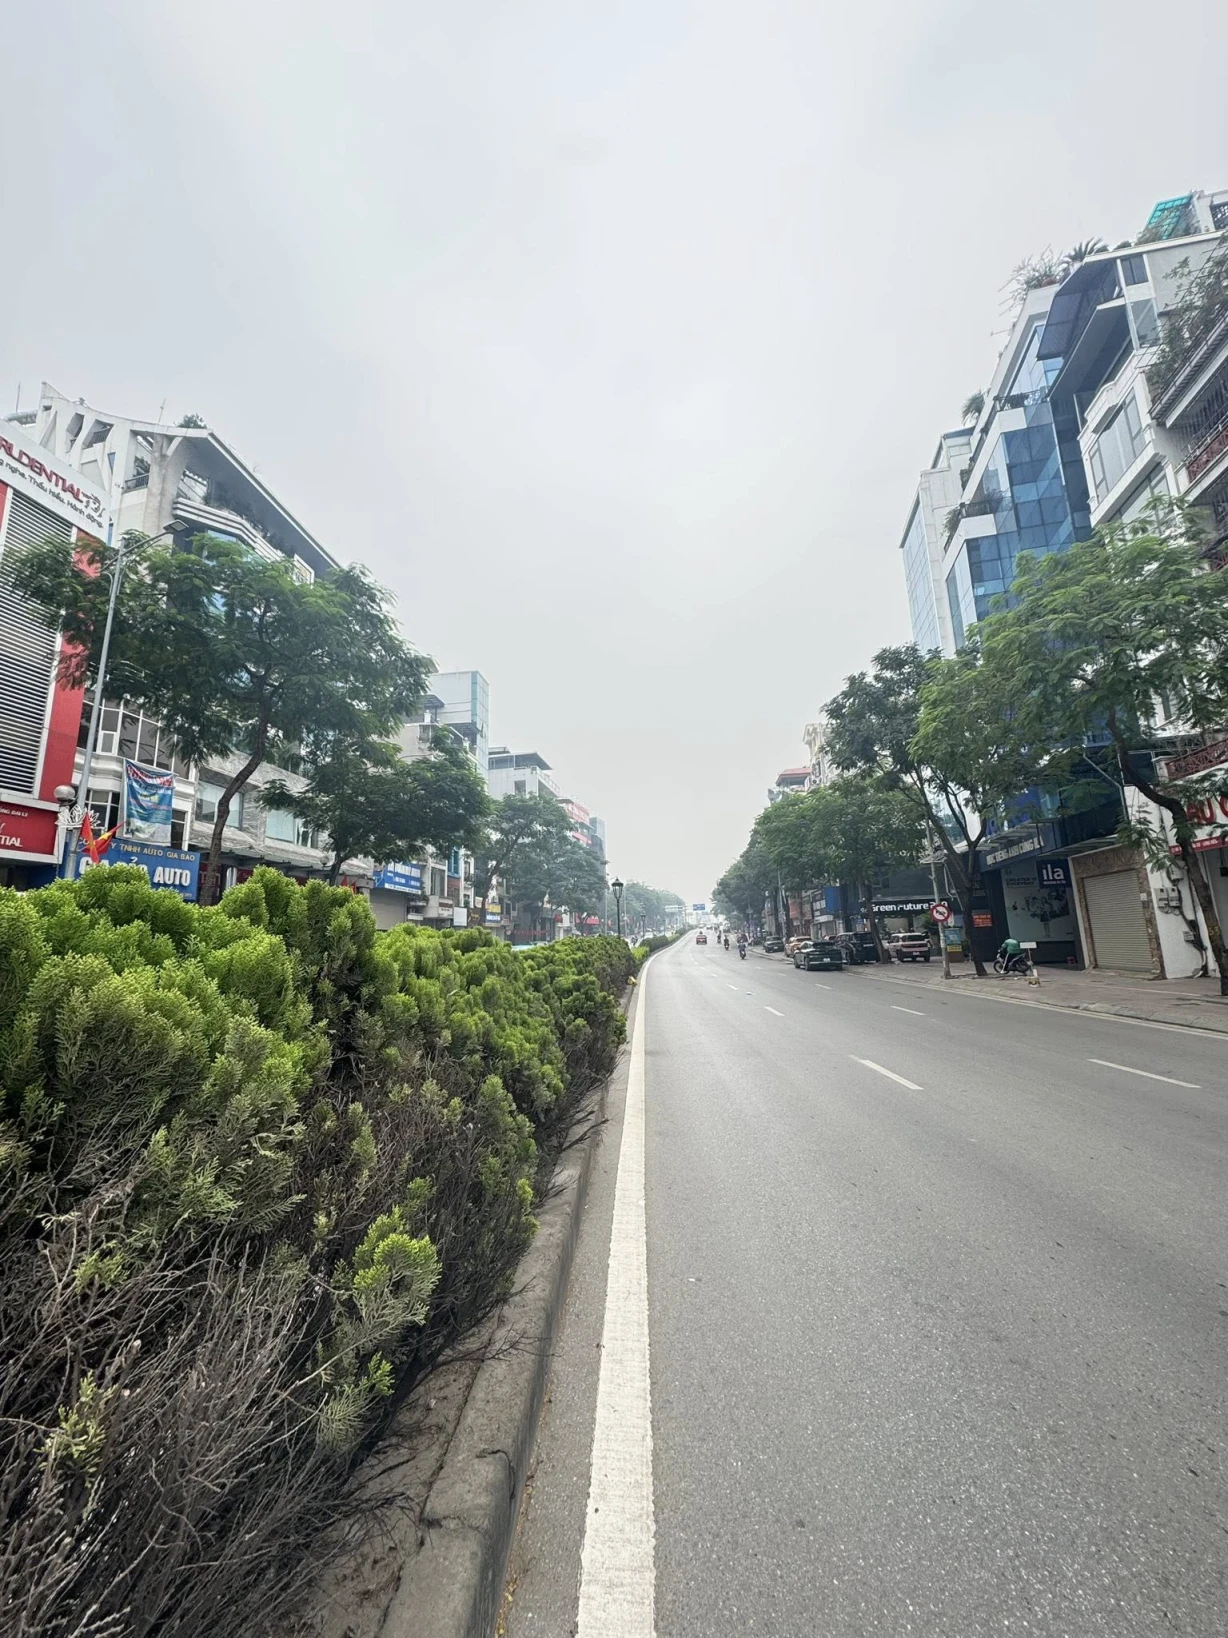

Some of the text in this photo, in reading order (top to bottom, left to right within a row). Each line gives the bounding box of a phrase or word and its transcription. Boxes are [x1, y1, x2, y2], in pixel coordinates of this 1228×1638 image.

[119, 843, 141, 854] TNHH
[166, 851, 178, 859] GIA
[152, 866, 191, 887] AUTO
[1042, 864, 1064, 880] ila
